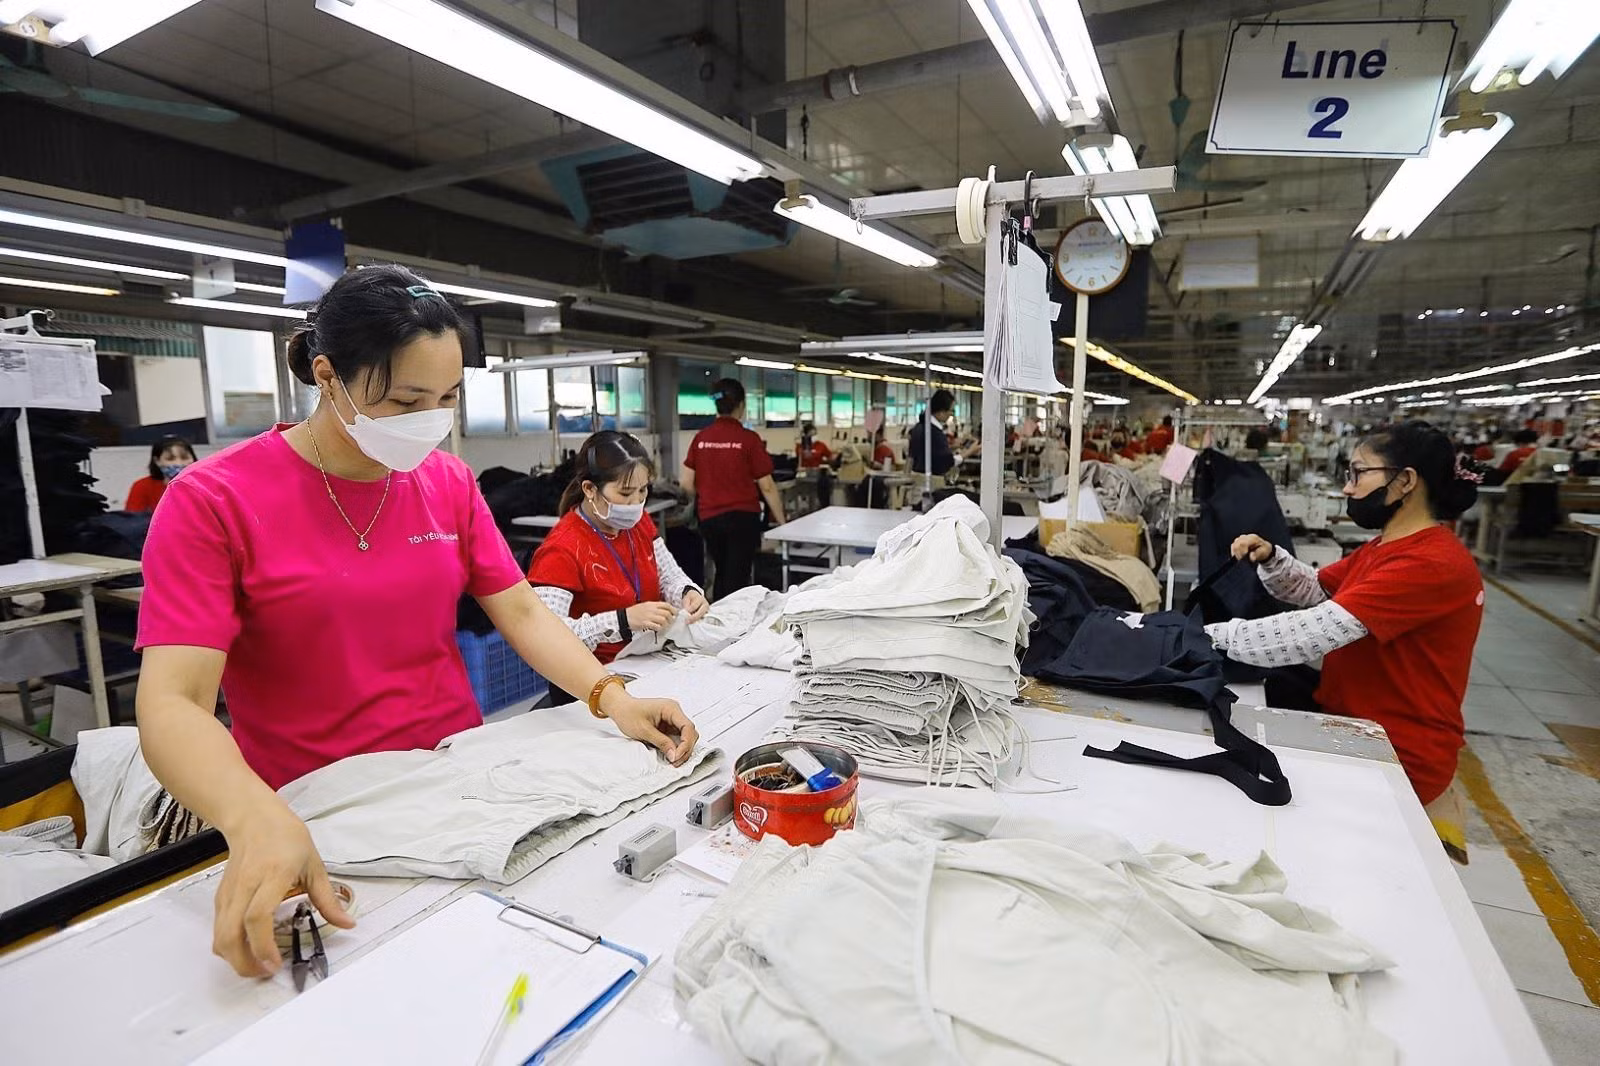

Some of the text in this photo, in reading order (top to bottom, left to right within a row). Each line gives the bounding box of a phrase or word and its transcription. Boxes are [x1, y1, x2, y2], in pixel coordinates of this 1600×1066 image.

[1281, 40, 1387, 79] Line
[1307, 97, 1350, 138] 2
[407, 536, 423, 544] TÔI
[423, 532, 440, 541] YÊU
